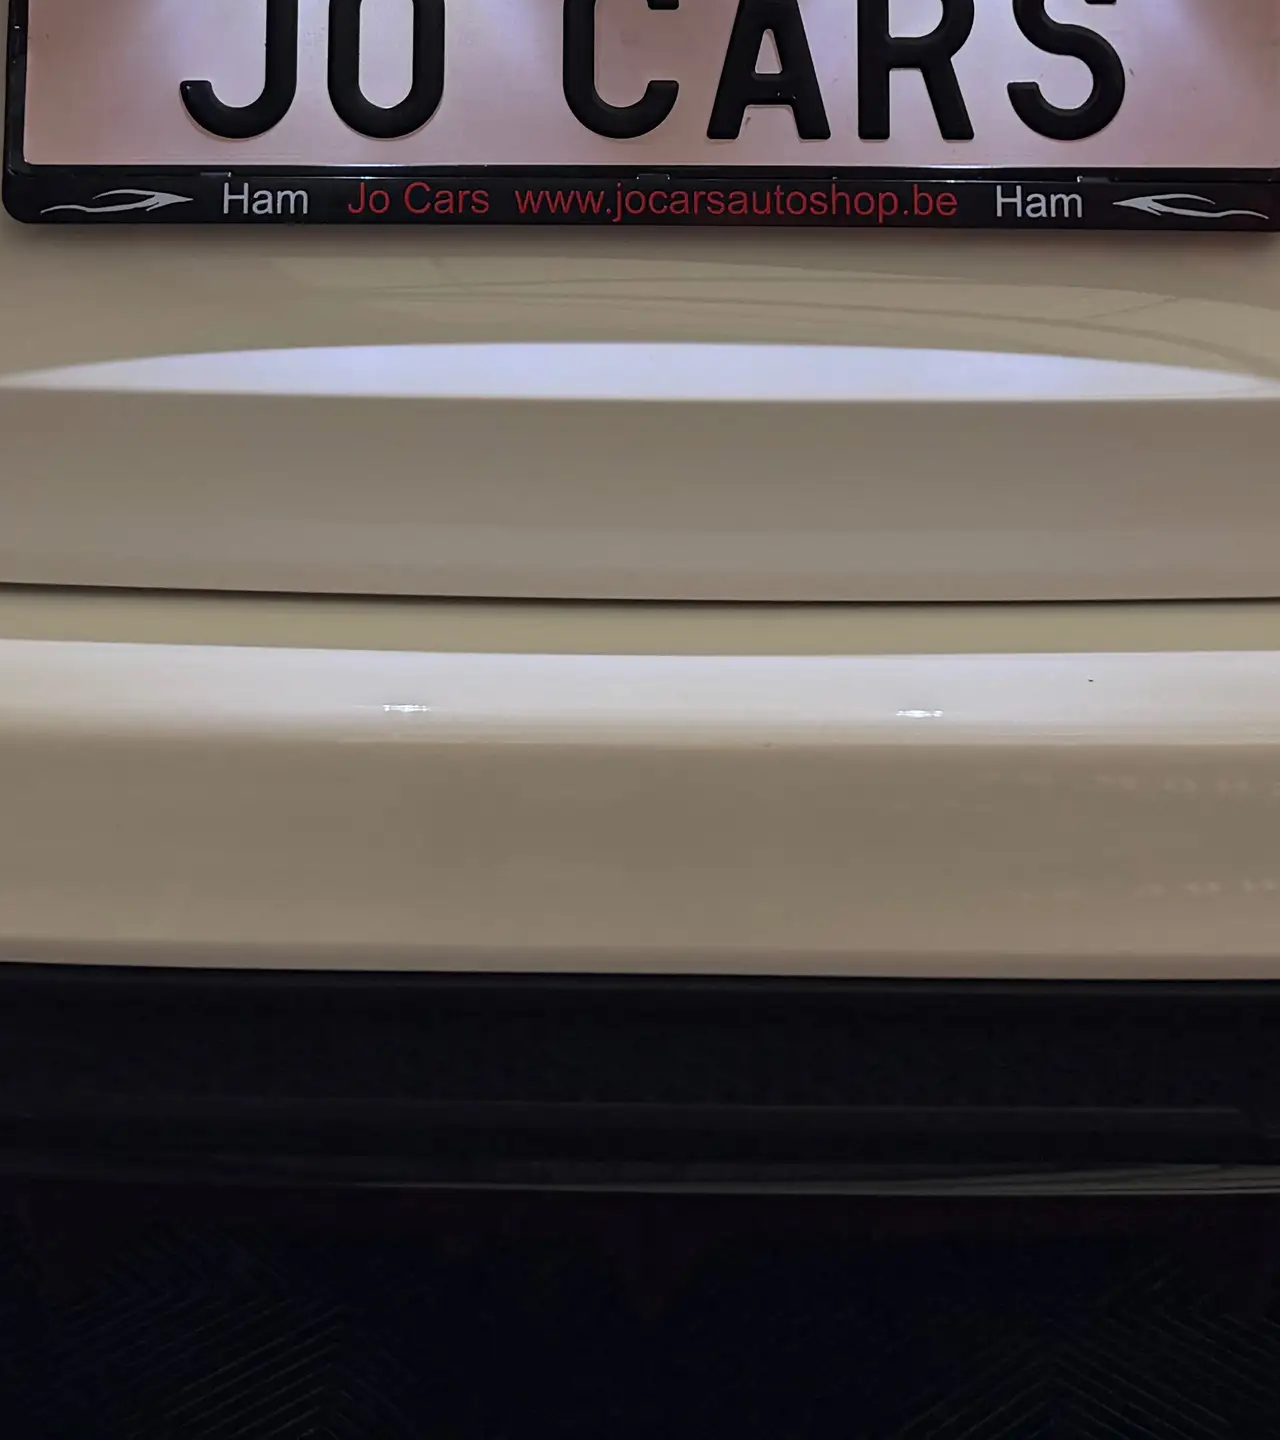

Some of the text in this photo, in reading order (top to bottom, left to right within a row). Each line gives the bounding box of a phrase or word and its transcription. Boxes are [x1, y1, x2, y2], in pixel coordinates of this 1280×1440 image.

[223, 181, 1083, 223] Ham Jo Cars www.jocarsautoshop.be Ham
